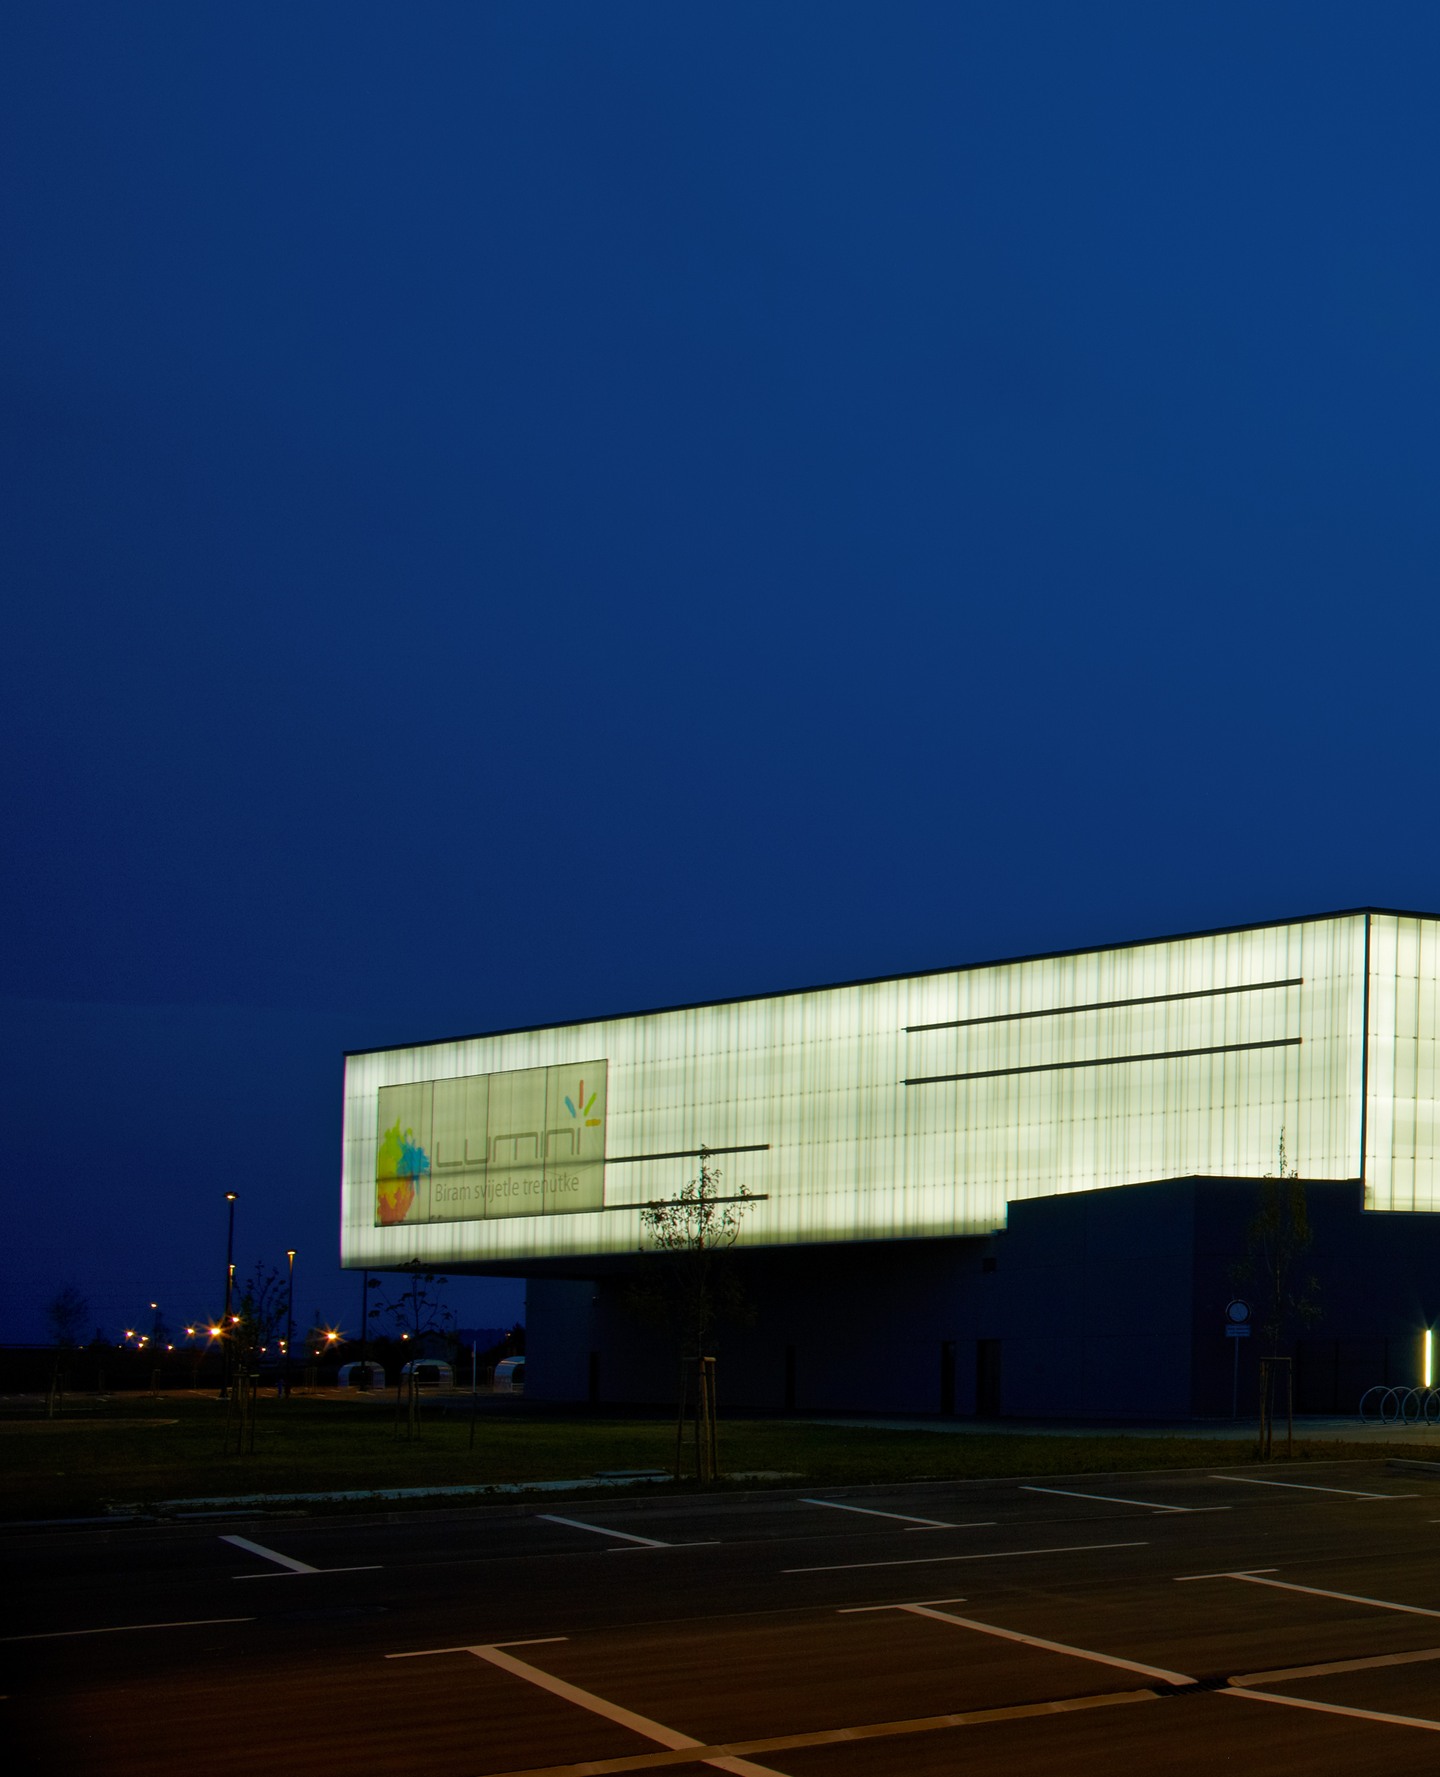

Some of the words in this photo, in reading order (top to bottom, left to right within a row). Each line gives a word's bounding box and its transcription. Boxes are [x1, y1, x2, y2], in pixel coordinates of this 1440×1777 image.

[435, 1184, 471, 1202] Biram
[474, 1177, 520, 1203] svijetle
[523, 1172, 580, 1194] trenutke
